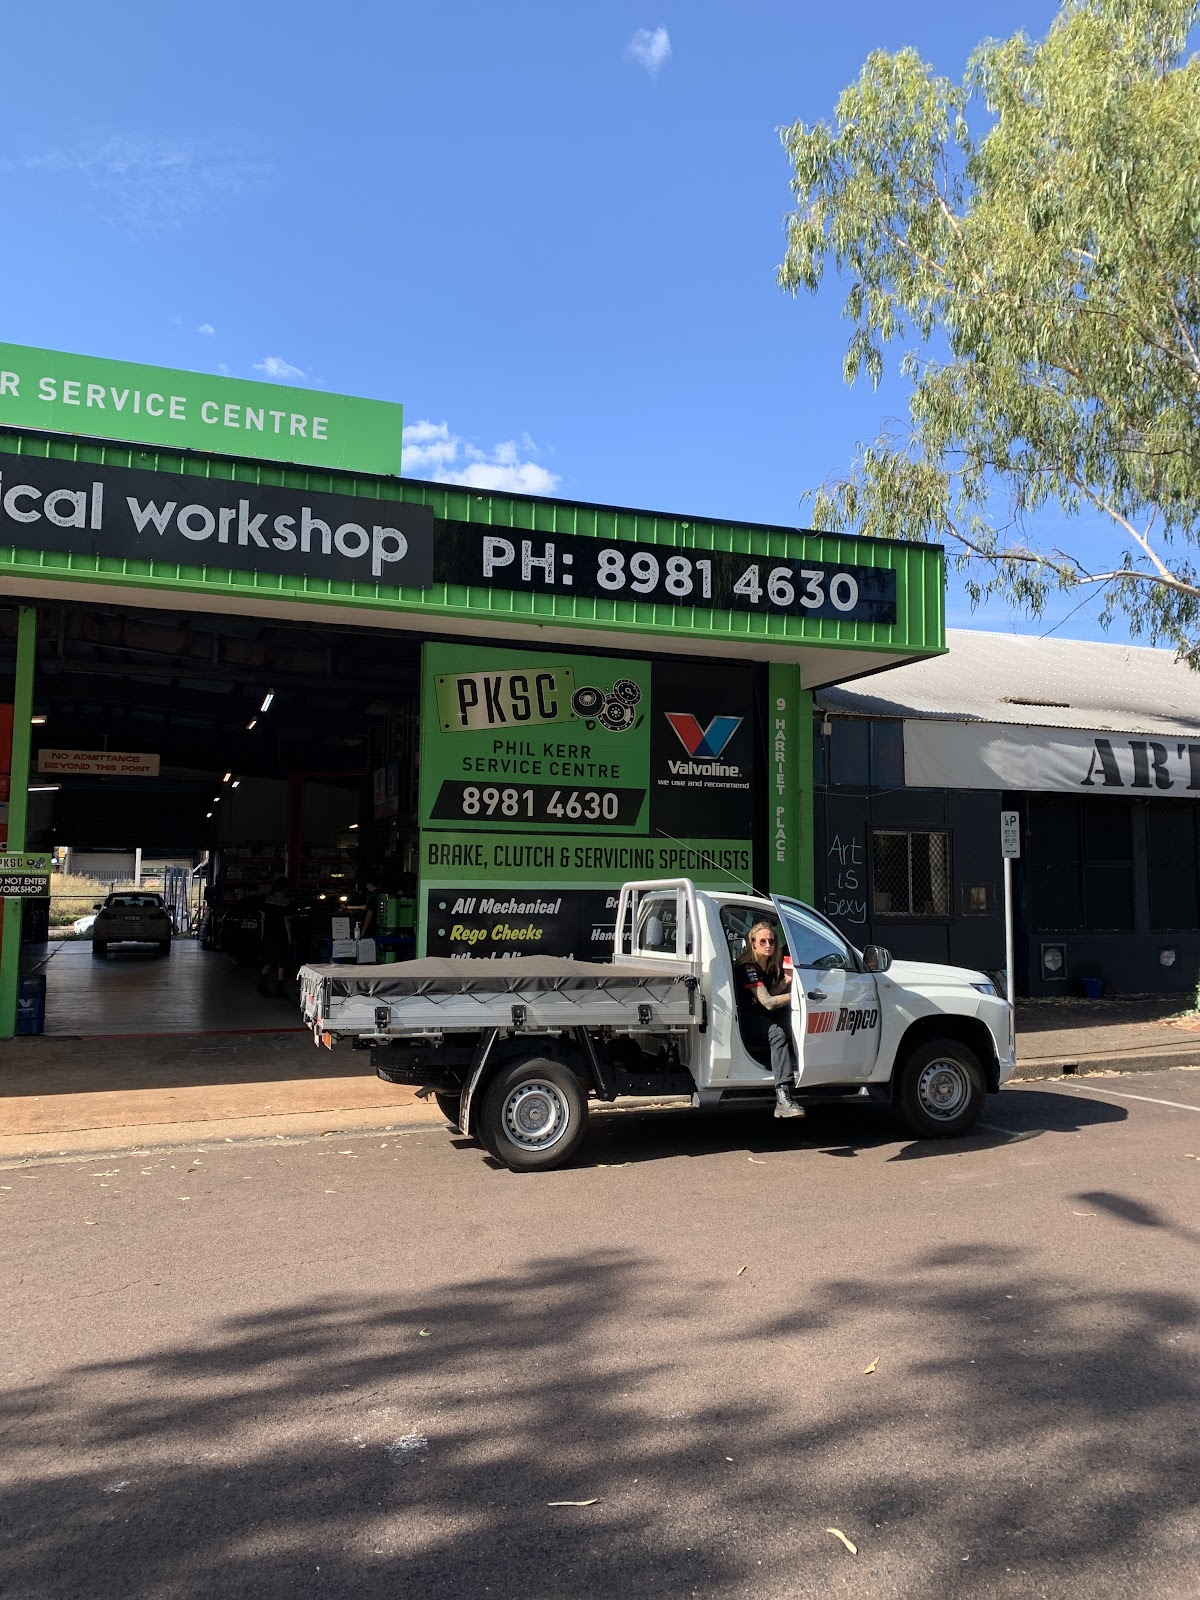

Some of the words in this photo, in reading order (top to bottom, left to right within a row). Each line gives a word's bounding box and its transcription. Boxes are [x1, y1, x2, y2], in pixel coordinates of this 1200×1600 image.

[37, 377, 187, 421] SERVICE
[201, 400, 329, 441] CENTRE
[126, 496, 409, 577] workshop
[482, 535, 573, 586] PH:
[596, 548, 712, 599] 8981
[732, 563, 859, 613] 4630
[457, 674, 557, 726] PKSC
[776, 697, 786, 712] 9
[51, 752, 69, 760] NO
[72, 753, 141, 763] ADMITTANCE
[492, 739, 536, 758] PHIL
[543, 742, 592, 760] KERR
[774, 718, 787, 796] HARRIET
[44, 762, 91, 770] BEYOND
[94, 763, 117, 771] THIS
[121, 765, 151, 773] POINT
[462, 757, 543, 775] SERVICE
[549, 760, 621, 779] CENTRE
[704, 781, 750, 789] recommend
[462, 786, 535, 817] 8981
[546, 790, 619, 820] 4630
[774, 806, 787, 862] PLACE
[428, 843, 488, 870] BRAKE,
[493, 845, 554, 868] CLUTCH
[560, 847, 570, 867] &
[574, 847, 654, 869] SERVICING
[659, 848, 750, 871] SPECIALISTS
[827, 834, 863, 866] Art
[4, 877, 23, 885] NOT
[24, 877, 48, 885] ENTER
[450, 898, 475, 915] All
[479, 898, 562, 915] Mechanical
[823, 892, 867, 924] Sexy
[450, 924, 488, 945] Rego
[491, 923, 543, 941] Checks
[836, 1007, 878, 1035] Repco
